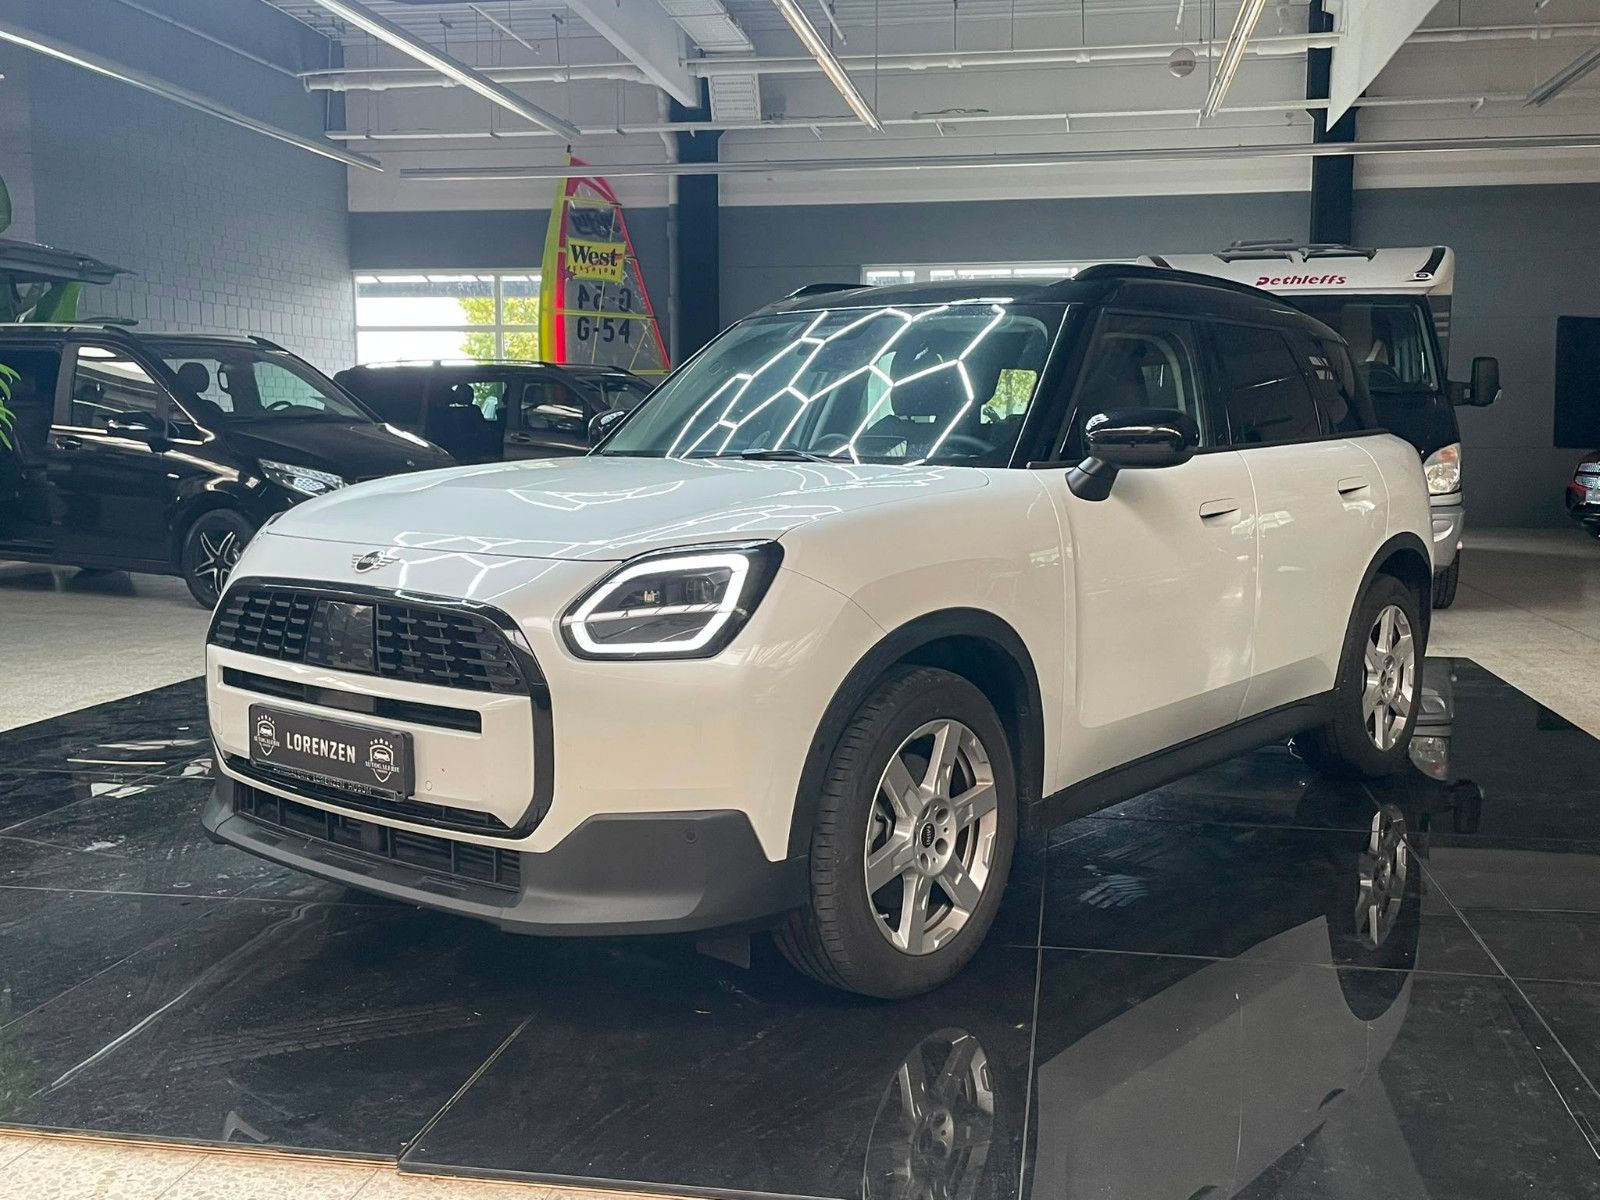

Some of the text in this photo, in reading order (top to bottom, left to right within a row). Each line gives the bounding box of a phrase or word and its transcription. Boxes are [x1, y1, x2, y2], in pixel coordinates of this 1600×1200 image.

[570, 244, 621, 267] West
[1256, 275, 1347, 287] Dethleffs
[577, 317, 629, 344] G-54
[286, 731, 356, 764] LORENZEN
[365, 760, 400, 773] AUTOGALERIE
